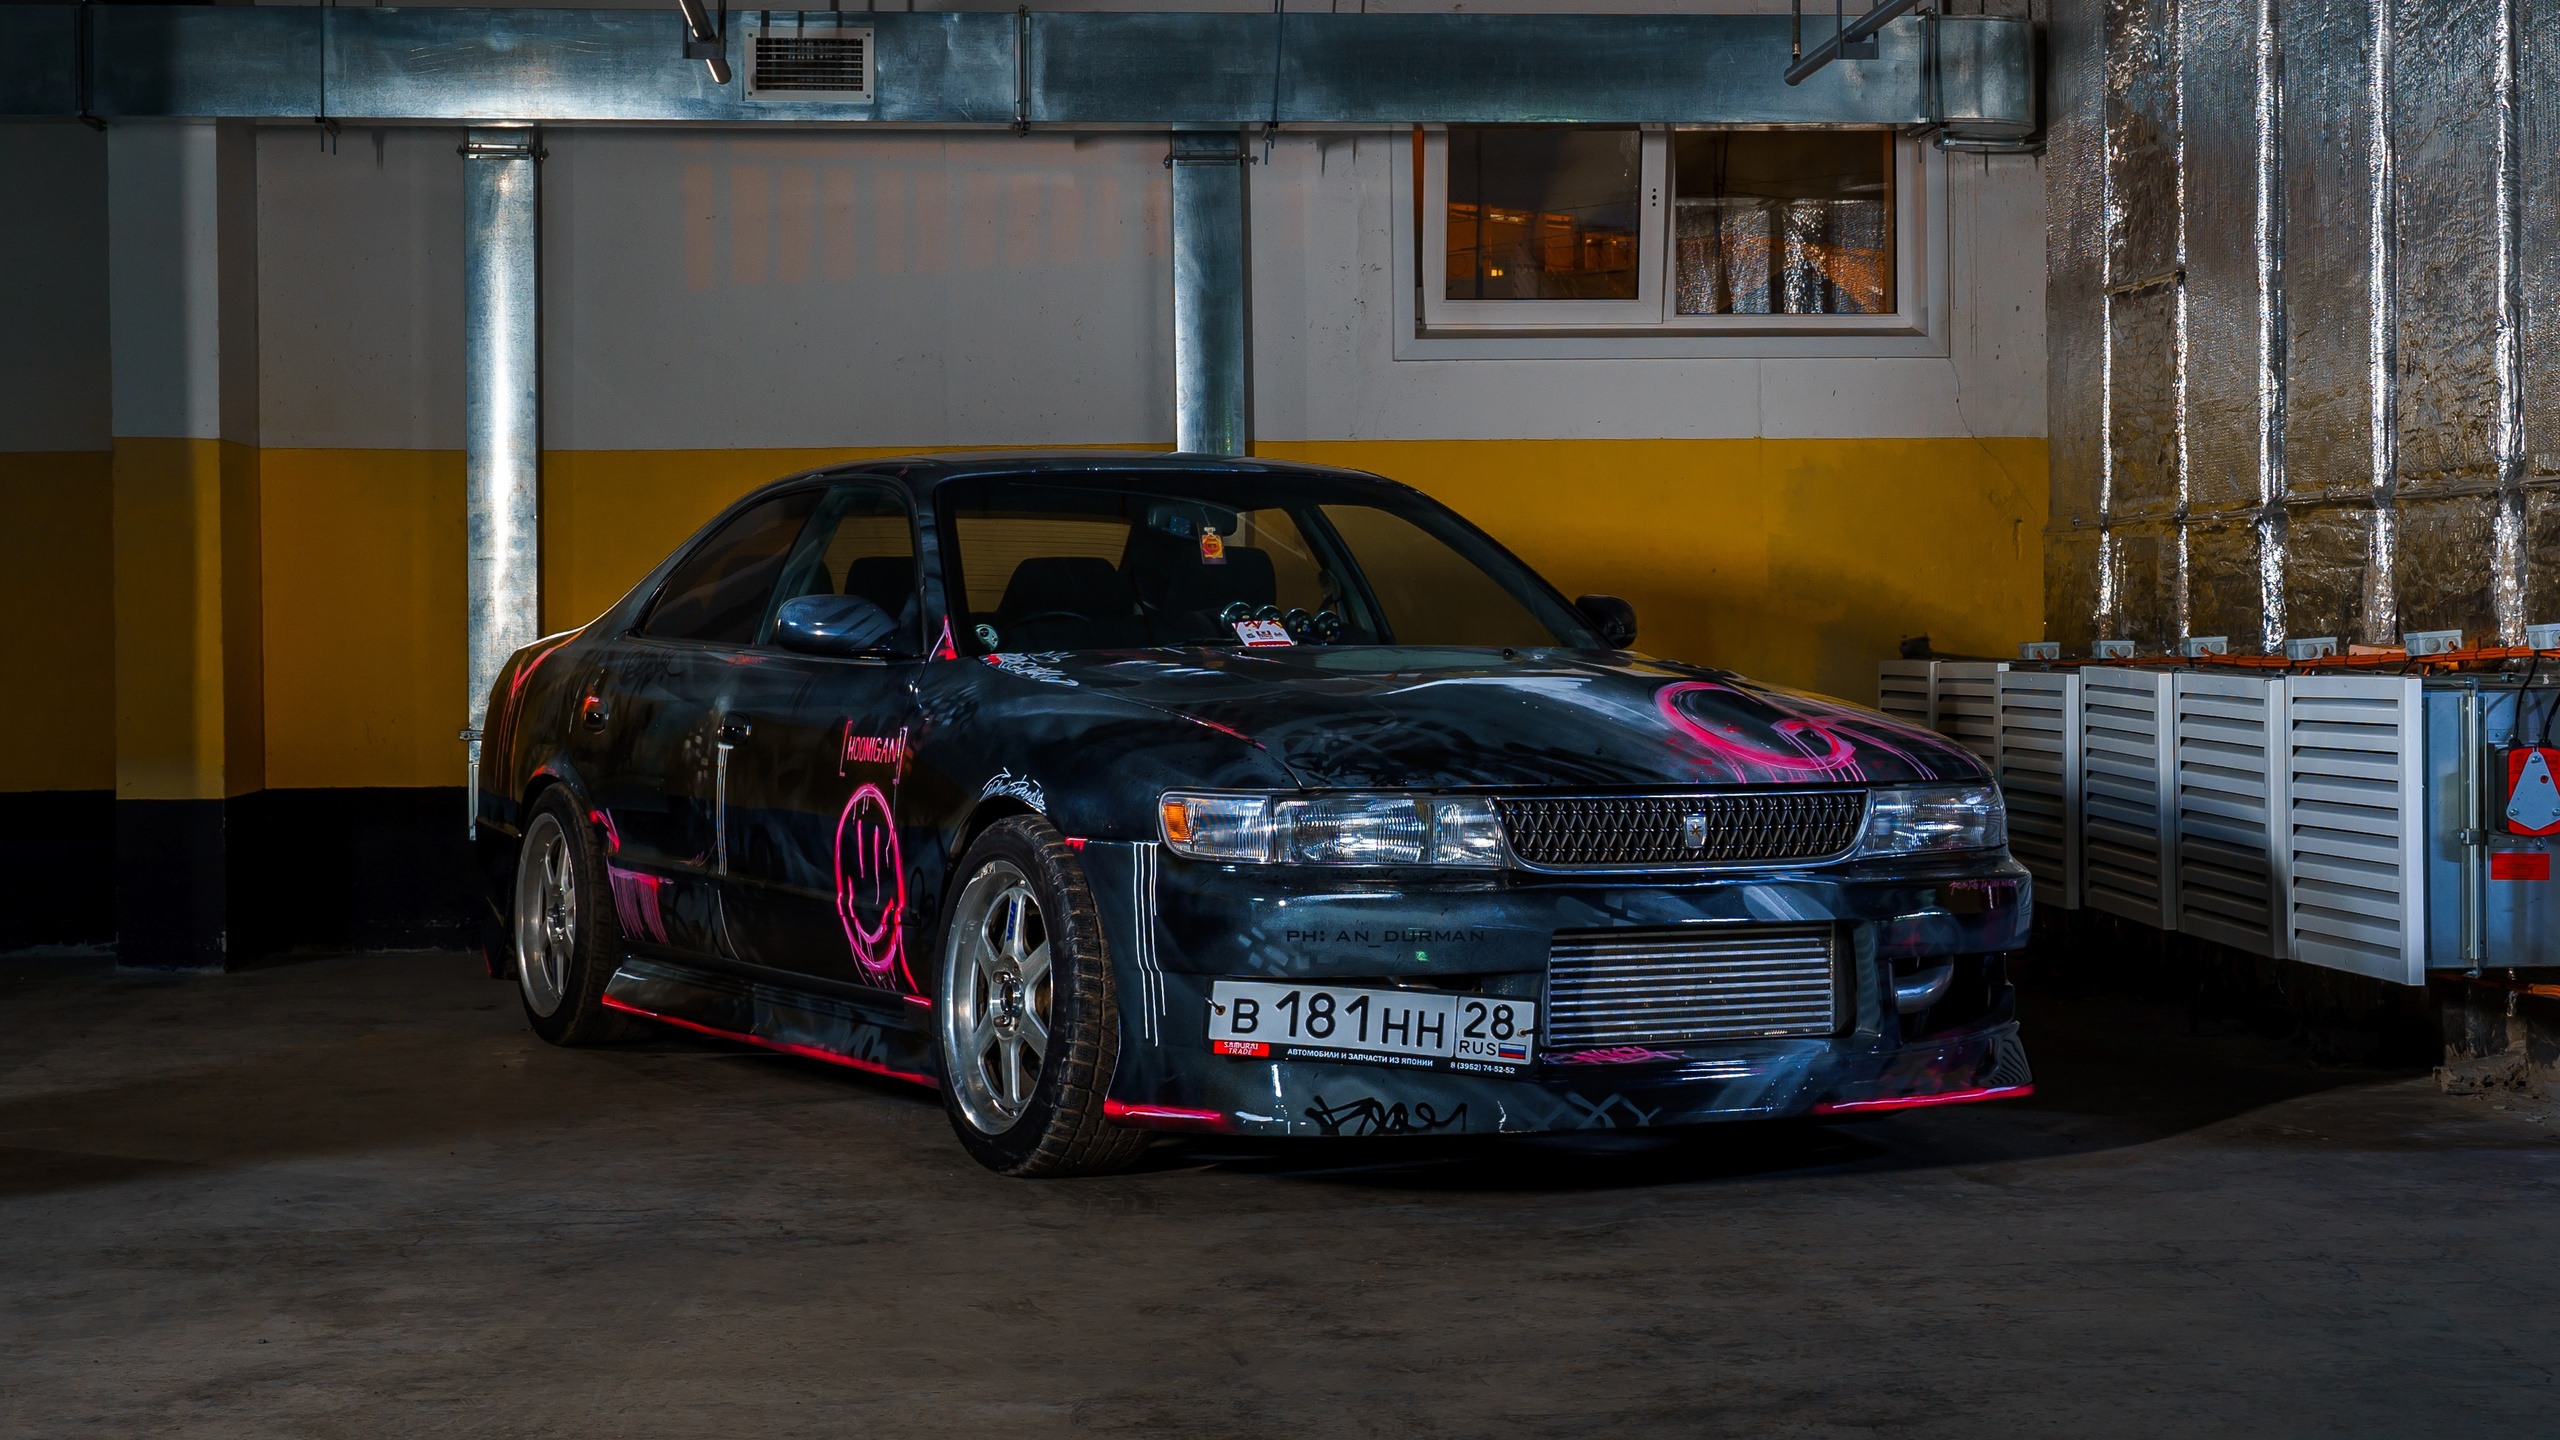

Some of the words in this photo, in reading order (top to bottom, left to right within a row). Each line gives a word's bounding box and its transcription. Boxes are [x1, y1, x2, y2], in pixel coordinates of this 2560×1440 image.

[1463, 1001, 1515, 1041] 28
[1224, 1041, 1259, 1050] SAMURAI
[1459, 1040, 1496, 1056] RUS
[1287, 1048, 1340, 1059] АВТОМОБИЛИ
[1348, 1053, 1388, 1063] ЗАПЧАСТИ
[1401, 1058, 1434, 1067] ЯПОНИИ
[1457, 1062, 1482, 1072] (3952)
[1483, 1064, 1516, 1075] 74-52-52
